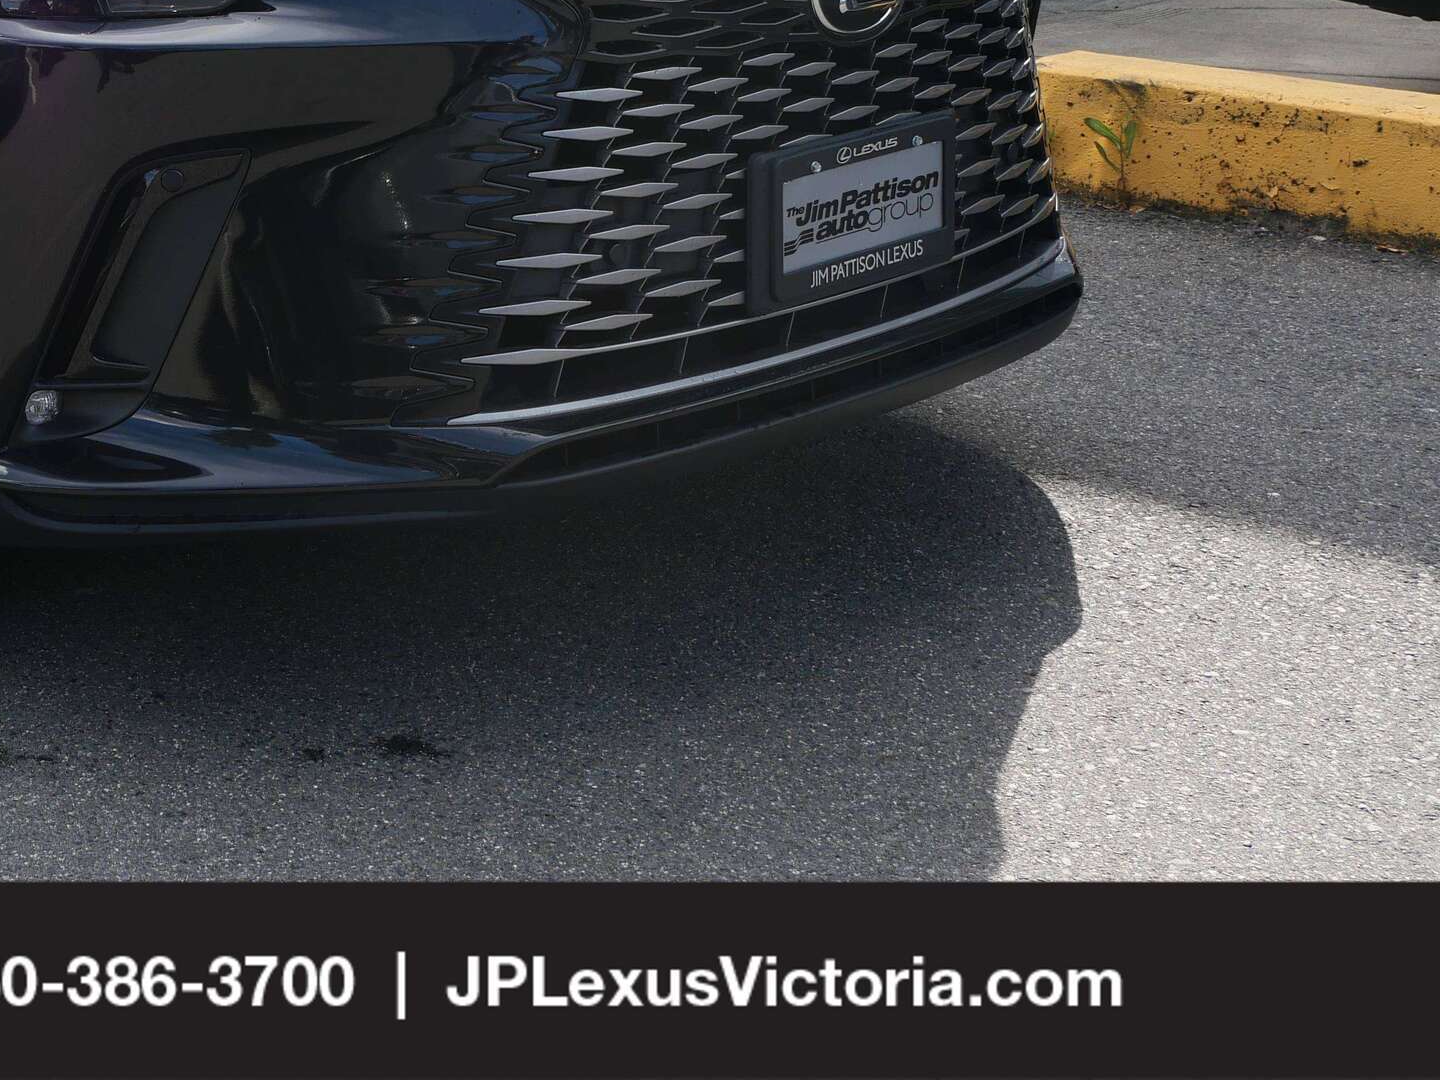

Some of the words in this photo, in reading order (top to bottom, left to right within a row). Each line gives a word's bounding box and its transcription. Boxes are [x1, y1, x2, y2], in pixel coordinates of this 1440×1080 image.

[853, 137, 898, 157] LEXUS
[786, 206, 806, 218] The
[811, 268, 830, 289] JIM
[831, 250, 886, 282] PATTISON
[887, 239, 924, 265] LEXUS
